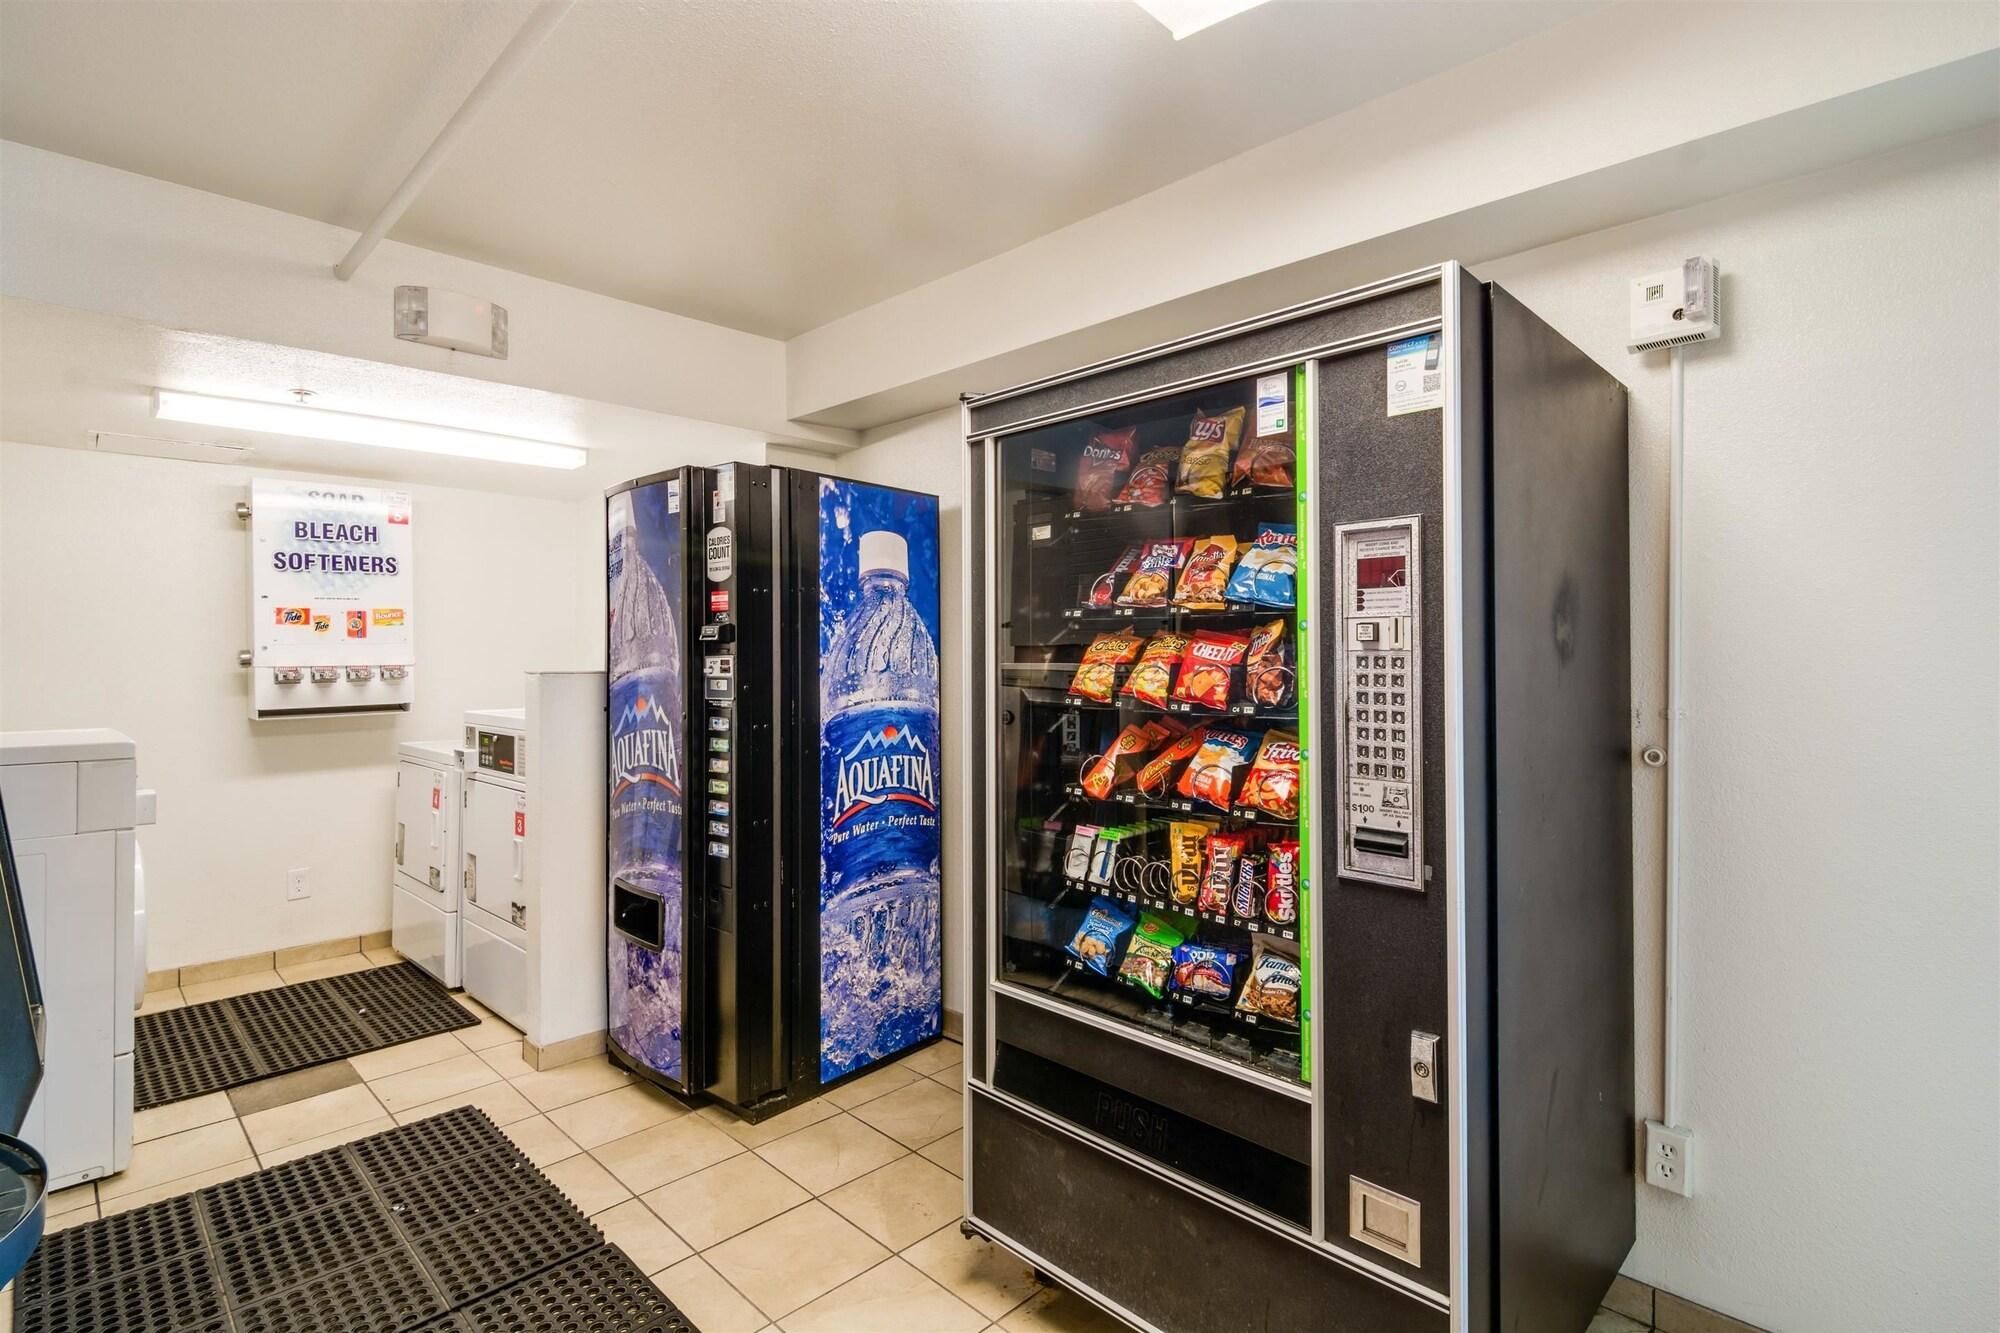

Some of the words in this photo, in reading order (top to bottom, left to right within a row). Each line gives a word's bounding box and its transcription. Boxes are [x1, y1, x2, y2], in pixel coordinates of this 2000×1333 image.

[1190, 419, 1225, 441] ay's
[1083, 446, 1121, 461] Doritos
[295, 521, 377, 542] BLEACH
[709, 535, 730, 547] CALORIES
[273, 552, 398, 574] SOFTENERS
[709, 545, 730, 560] COUNT
[284, 611, 302, 622] Tide
[315, 621, 330, 632] Tide
[1204, 729, 1248, 750] UFFLES
[611, 725, 681, 796] AQUAFINA
[1263, 741, 1299, 761] frito
[833, 750, 936, 823] AQUAFINA
[621, 800, 637, 814] Water
[642, 797, 666, 815] Perfect
[1351, 803, 1375, 814] $1.00
[517, 820, 523, 832] 3
[832, 829, 850, 845] Pure
[852, 821, 879, 837] Water
[888, 815, 917, 828] Perfect
[919, 815, 935, 827] Taste
[1237, 859, 1254, 917] SNICKERS
[1276, 852, 1296, 921] Skittles
[1256, 952, 1299, 974] Famo
[1095, 1092, 1168, 1152] PUSH
